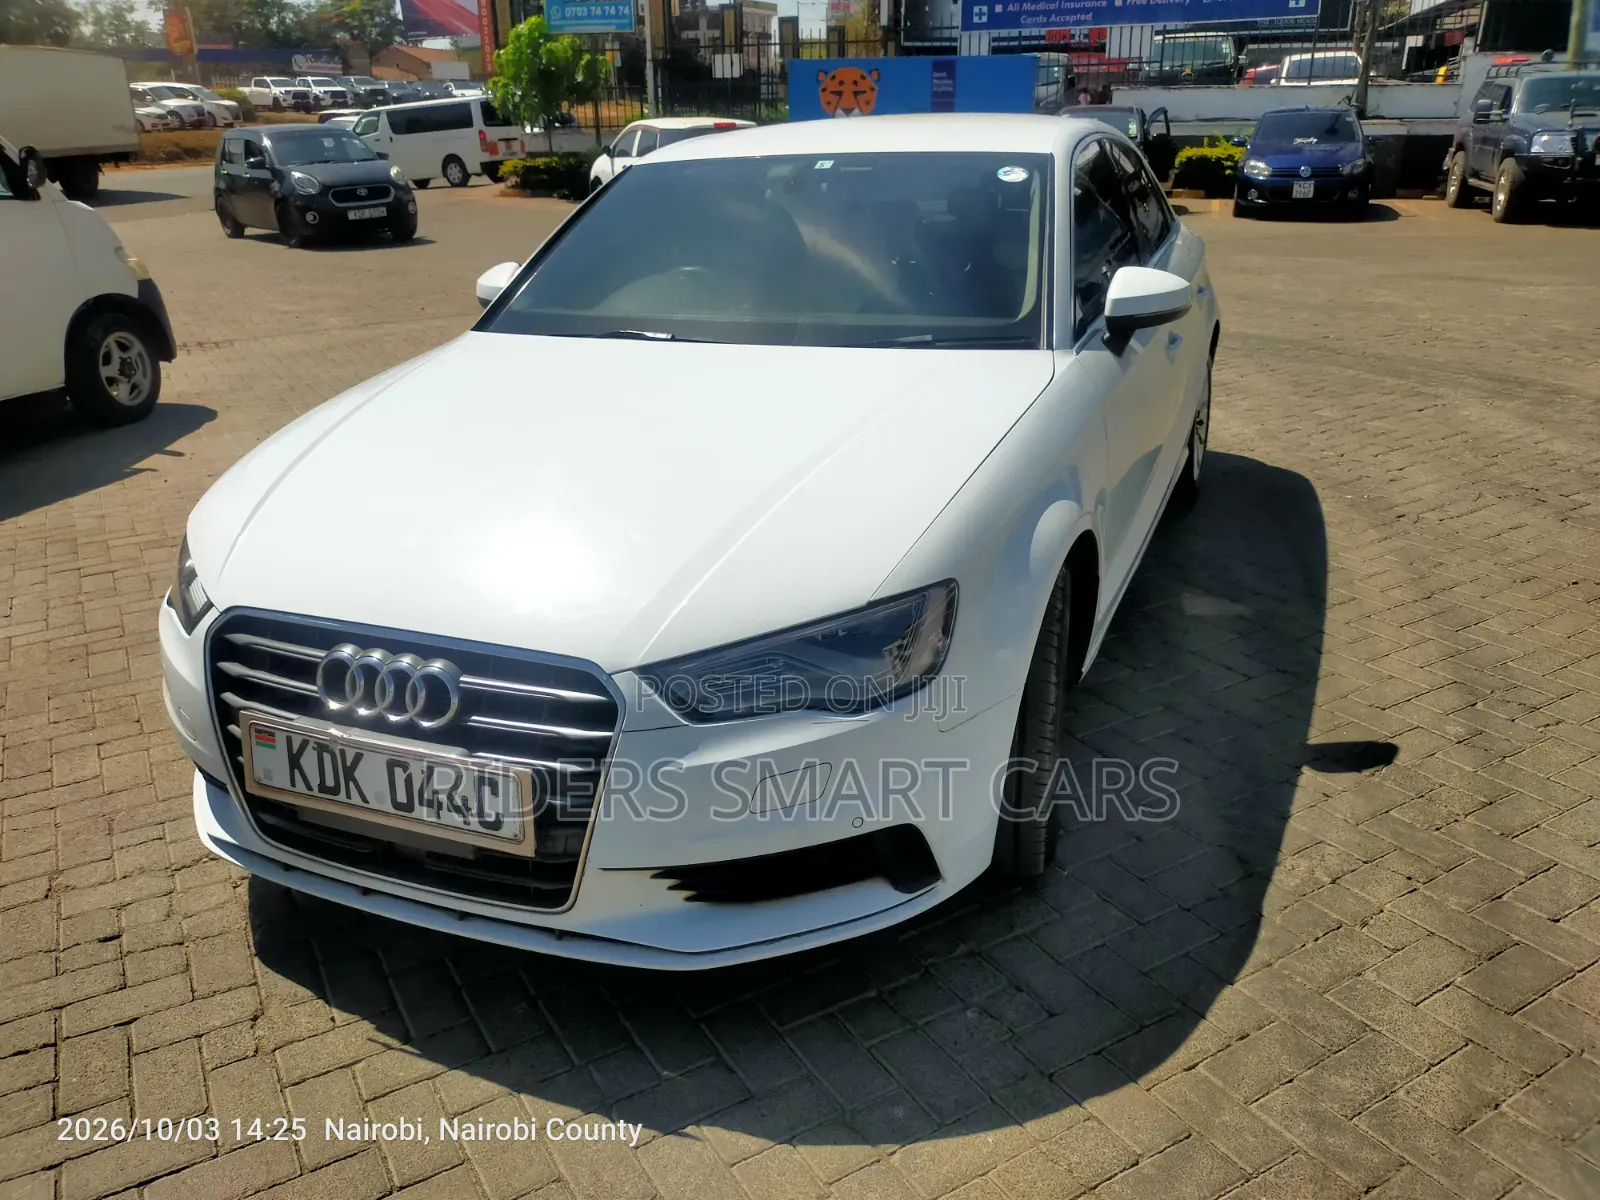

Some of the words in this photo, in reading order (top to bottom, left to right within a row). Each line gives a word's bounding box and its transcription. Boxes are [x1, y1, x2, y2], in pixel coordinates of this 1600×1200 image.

[565, 7, 588, 17] 0703
[590, 6, 602, 16] 74
[604, 6, 616, 16] 74
[618, 6, 630, 15] 74
[1007, 3, 1019, 12] All
[1021, 1, 1058, 11] Medical
[1061, 0, 1107, 9] Insurance
[1020, 15, 1048, 24] Cards
[1050, 12, 1093, 24] Accepted
[285, 734, 370, 805] KDK
